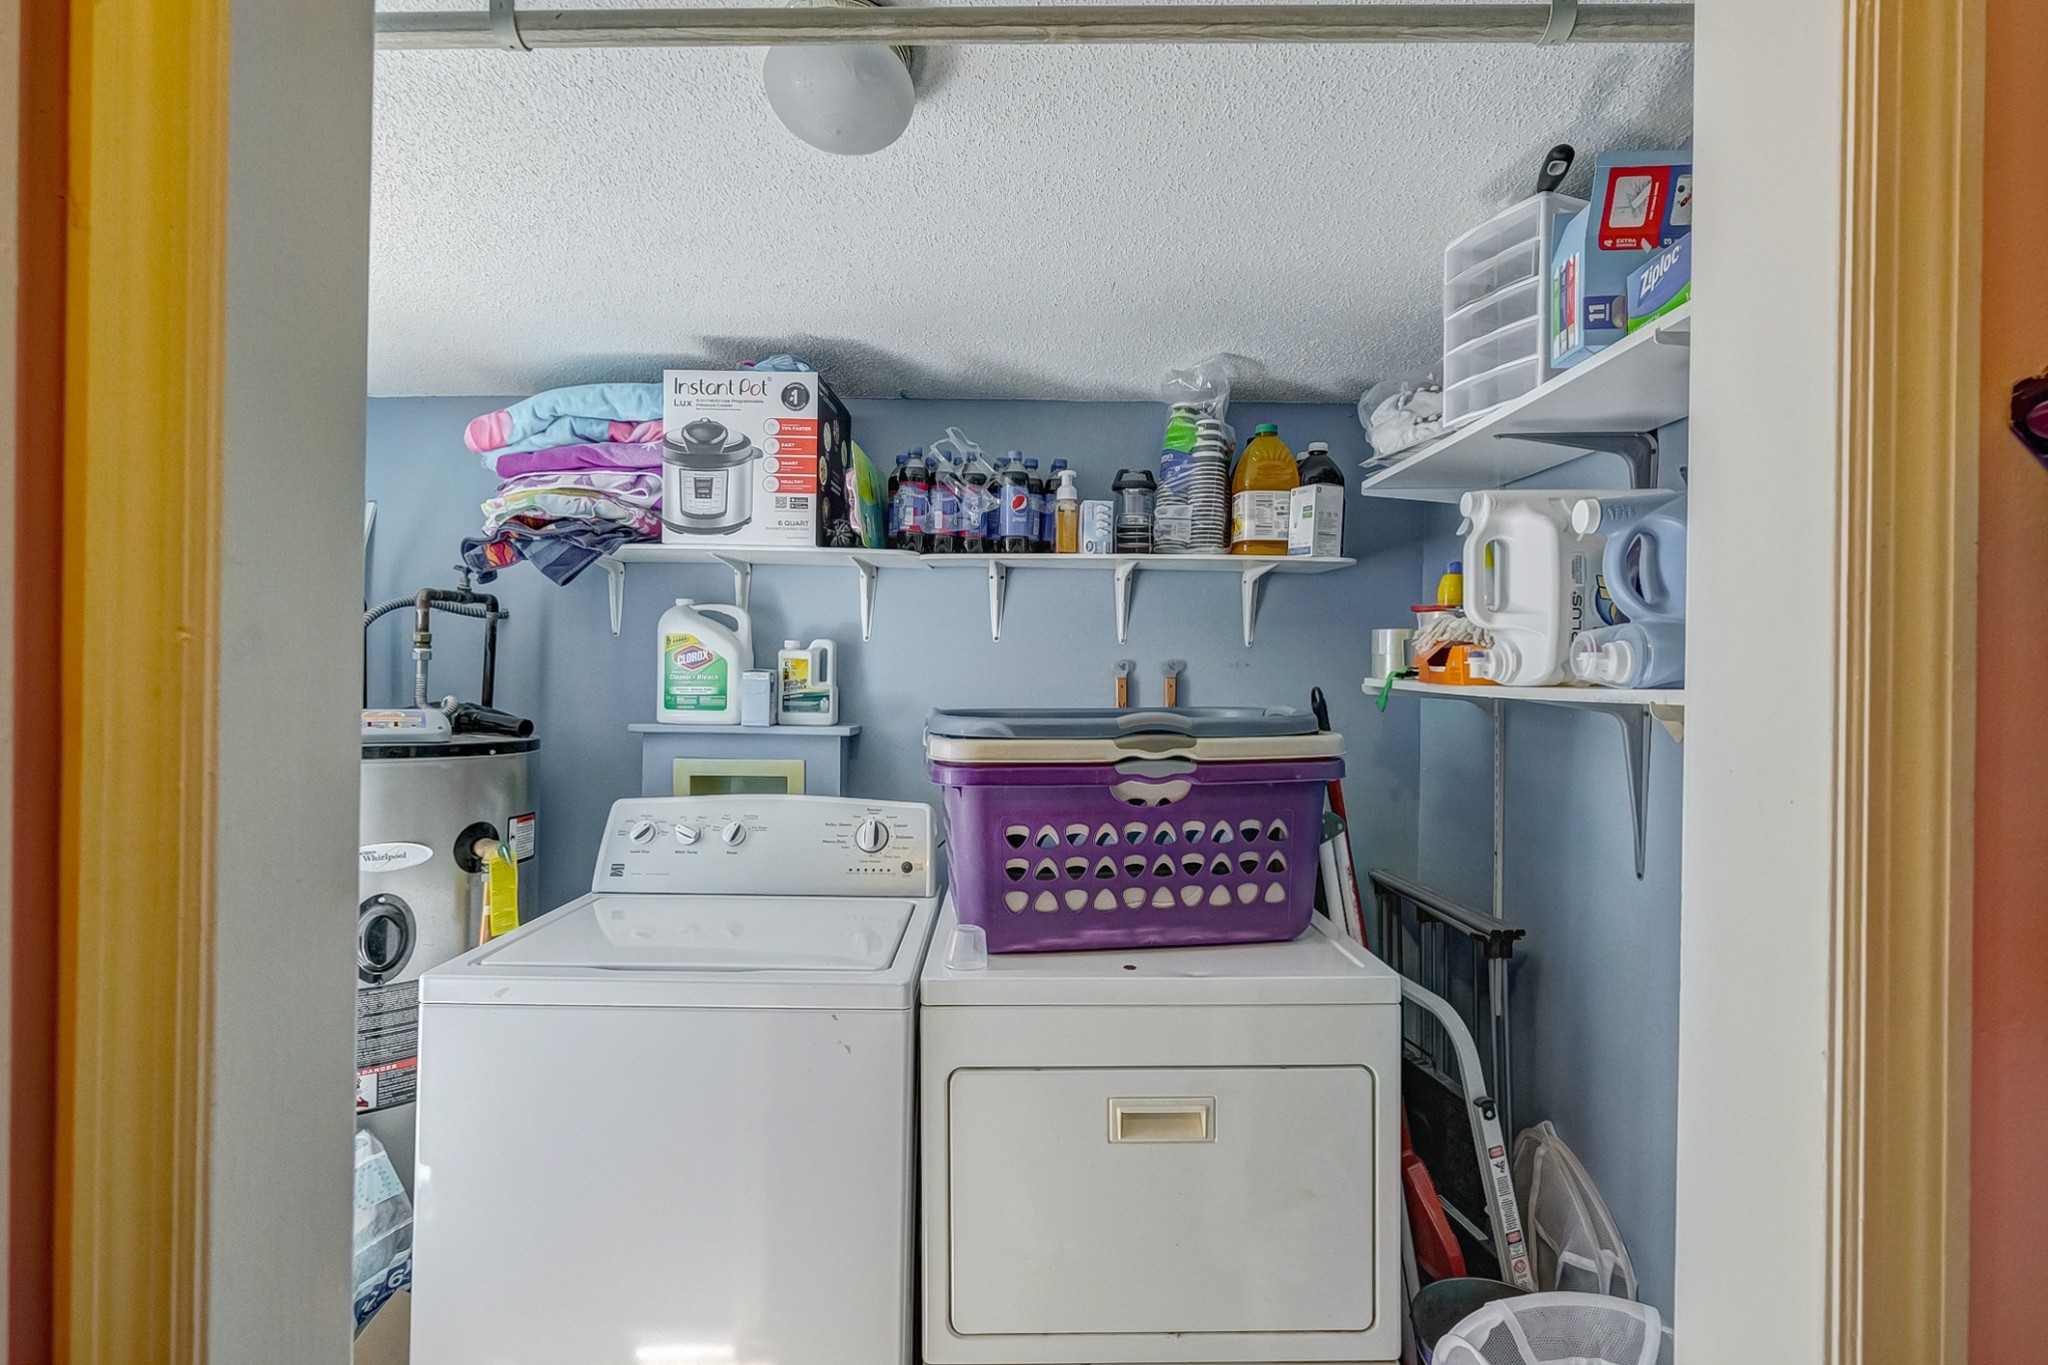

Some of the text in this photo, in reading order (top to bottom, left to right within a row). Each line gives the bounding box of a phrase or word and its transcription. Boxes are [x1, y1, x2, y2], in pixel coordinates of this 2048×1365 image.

[1640, 245, 1680, 298] Ziploc
[1588, 304, 1605, 322] 11
[674, 377, 768, 397] Instant Pot
[673, 399, 692, 407] Lux
[677, 648, 709, 665] CLOROX
[362, 851, 407, 862] Whirlpool
[362, 1064, 398, 1076] DANGER
[387, 1269, 405, 1289] 6
